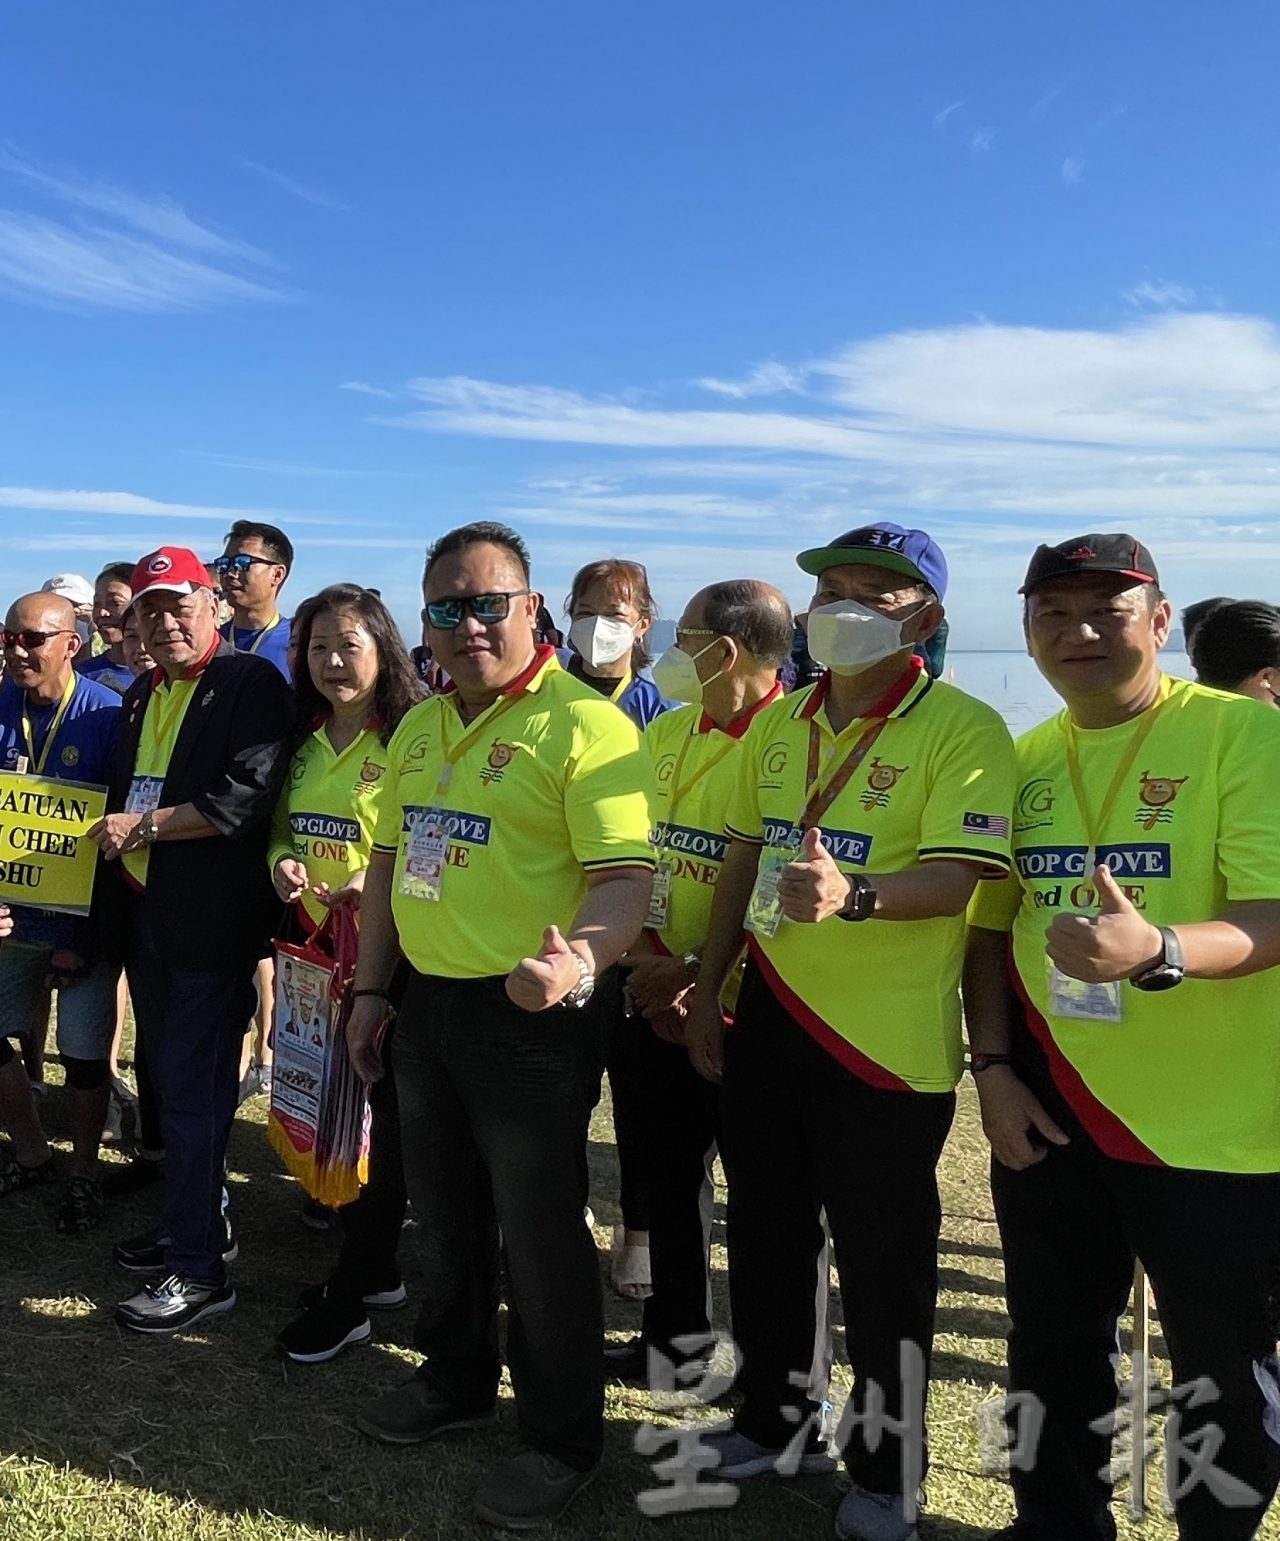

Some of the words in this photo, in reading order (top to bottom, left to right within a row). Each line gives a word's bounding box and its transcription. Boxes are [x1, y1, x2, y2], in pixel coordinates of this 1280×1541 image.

[291, 818, 306, 832] OP
[306, 818, 358, 840] GLOVE
[762, 824, 787, 842] OP
[9, 826, 79, 859] CHEE
[294, 842, 308, 855] ed
[312, 842, 350, 863] ONE
[1017, 853, 1061, 875] TOP
[1064, 850, 1164, 873] GOVE
[1070, 883, 1147, 909] OE
